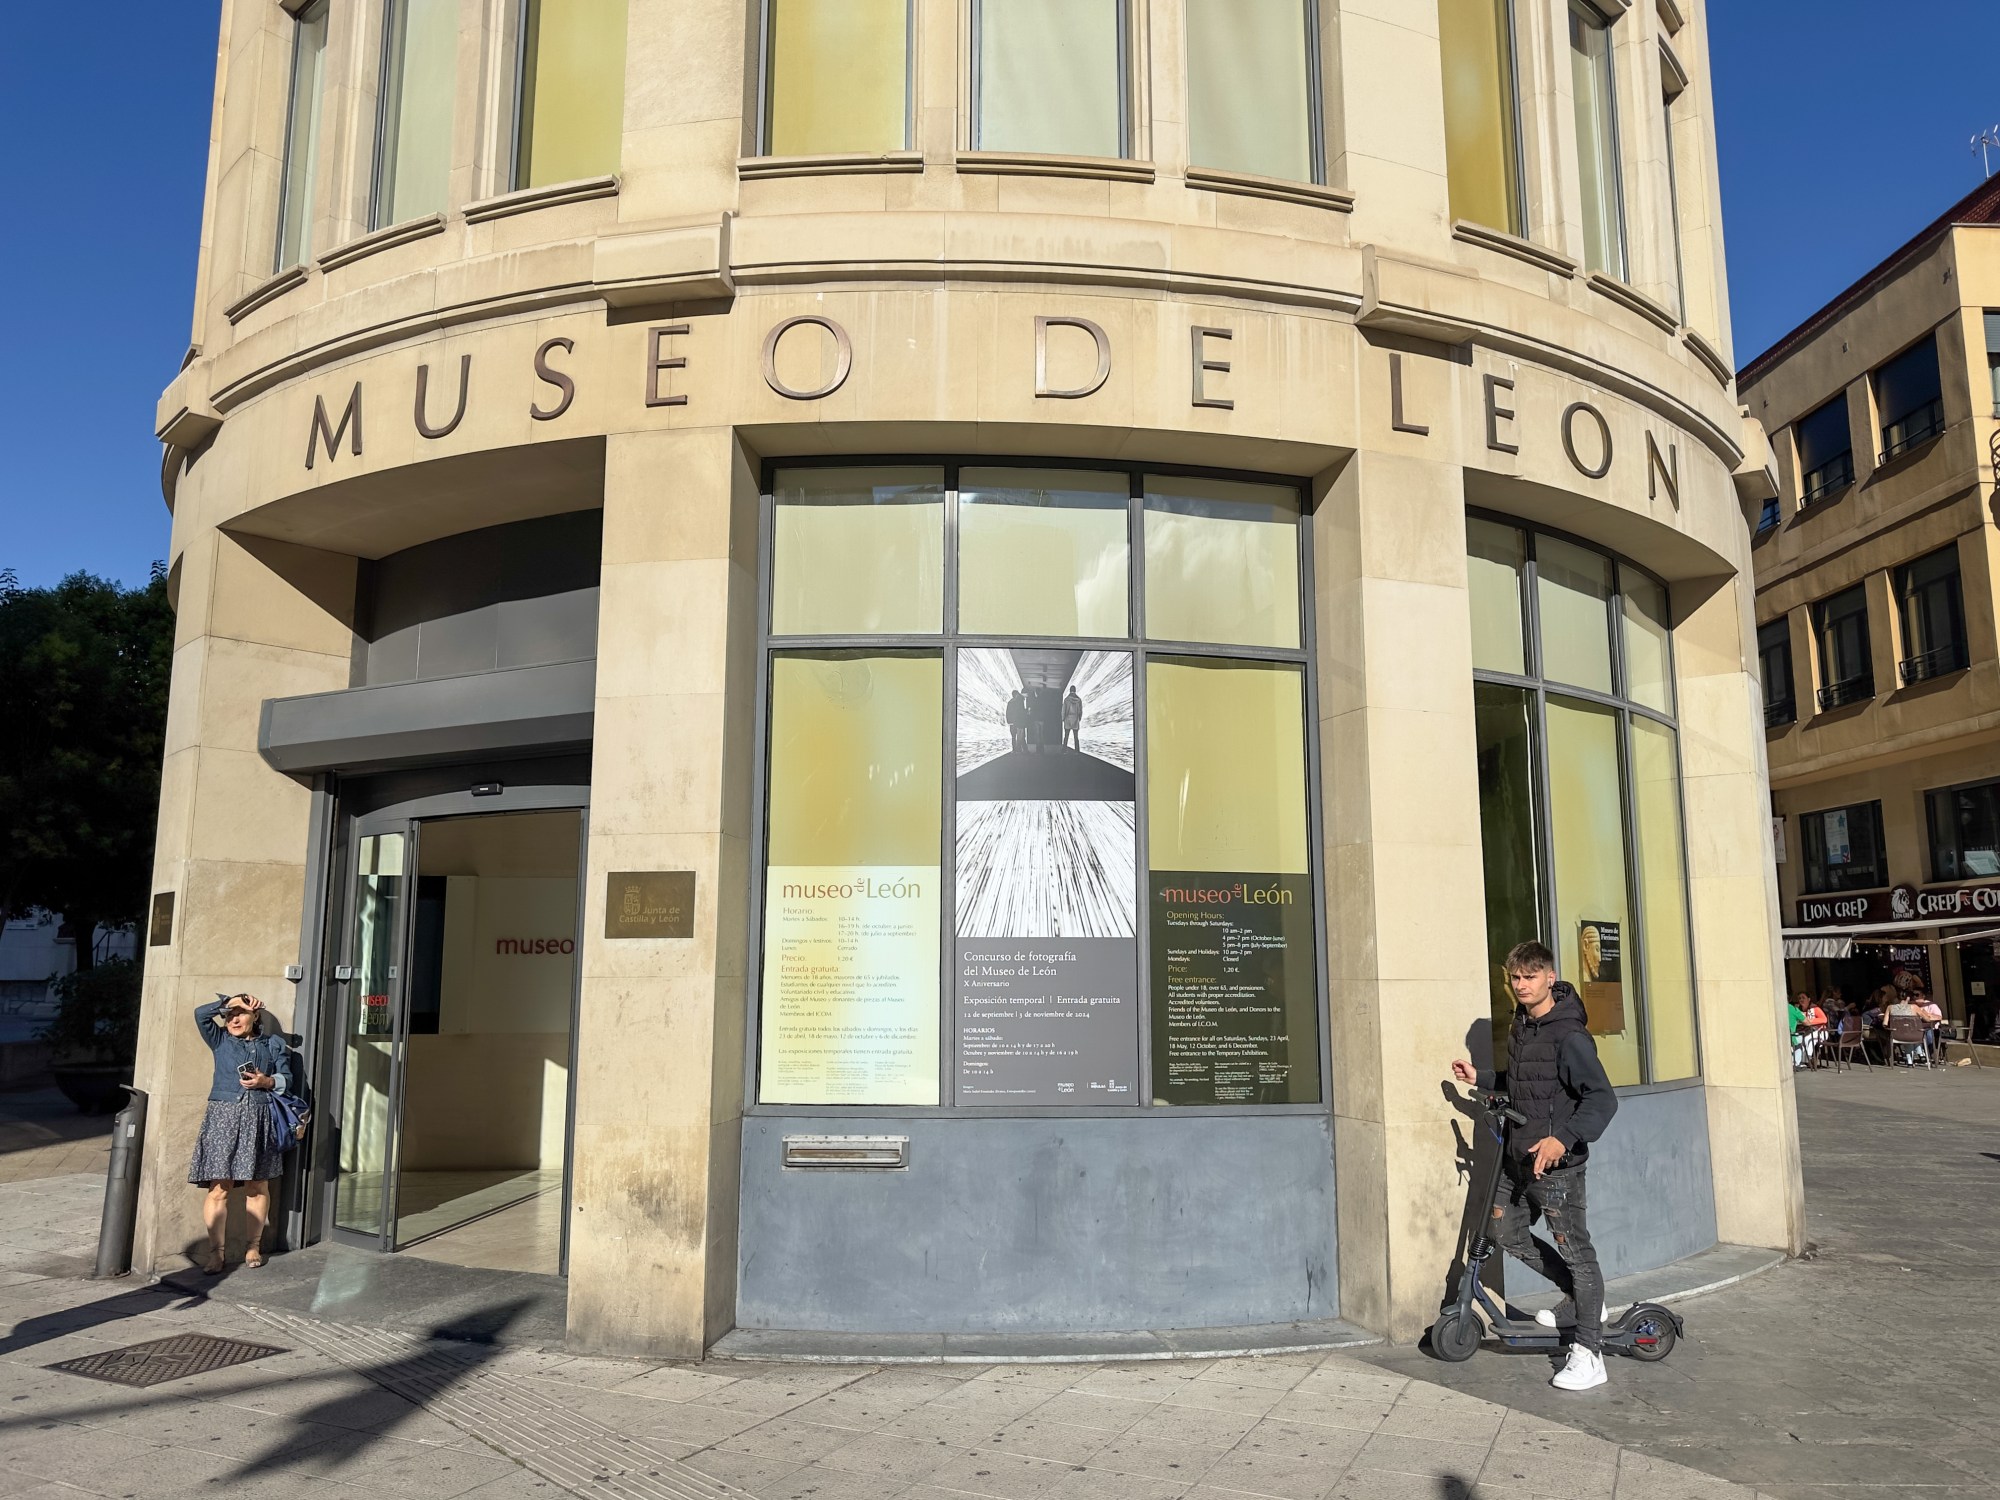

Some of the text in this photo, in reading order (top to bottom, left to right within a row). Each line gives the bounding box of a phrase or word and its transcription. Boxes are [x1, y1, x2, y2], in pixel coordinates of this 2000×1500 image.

[305, 314, 1680, 512] MUSEO DE LEON
[783, 877, 920, 898] museo de León
[1166, 883, 1293, 904] museo de León
[1803, 898, 1868, 922] LION CREP
[1917, 890, 1970, 914] CREPS
[651, 916, 656, 924] y
[1167, 911, 1198, 920] Opening
[496, 937, 575, 955] museo
[964, 951, 1076, 963] Concurso de fotografía
[964, 966, 1057, 976] del Museo de León
[964, 996, 1007, 1005] Exposición
[1010, 996, 1045, 1006] temporal
[1090, 996, 1120, 1005] gratuita
